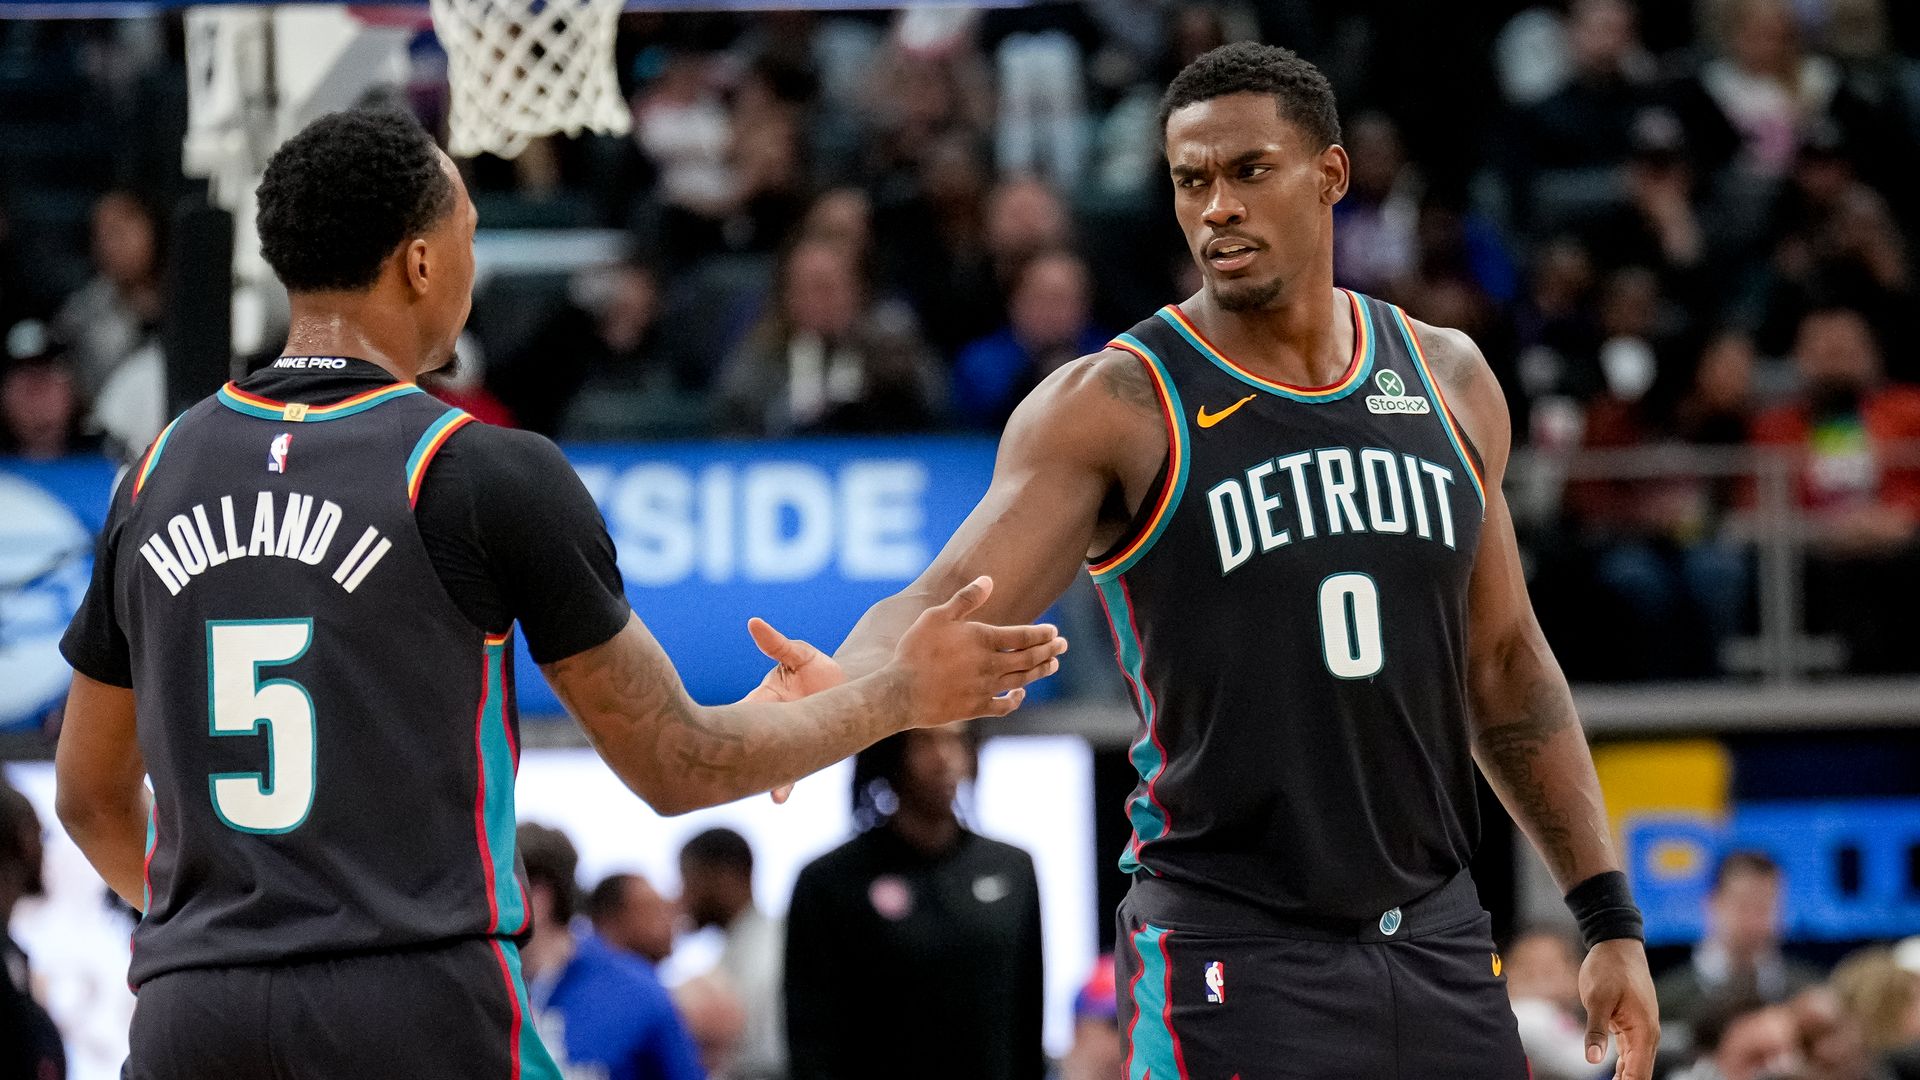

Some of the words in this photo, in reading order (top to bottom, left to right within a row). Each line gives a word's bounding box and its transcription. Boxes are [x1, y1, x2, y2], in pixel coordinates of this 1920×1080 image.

[273, 357, 308, 369] NIKE
[308, 357, 347, 369] PRO
[1368, 397, 1428, 412] StockX
[139, 490, 343, 597] HOLLAND
[331, 524, 393, 594] II
[576, 459, 929, 588] SIDE
[1206, 446, 1456, 577] DETROIT
[1317, 571, 1385, 681] 0
[205, 617, 317, 835] 5
